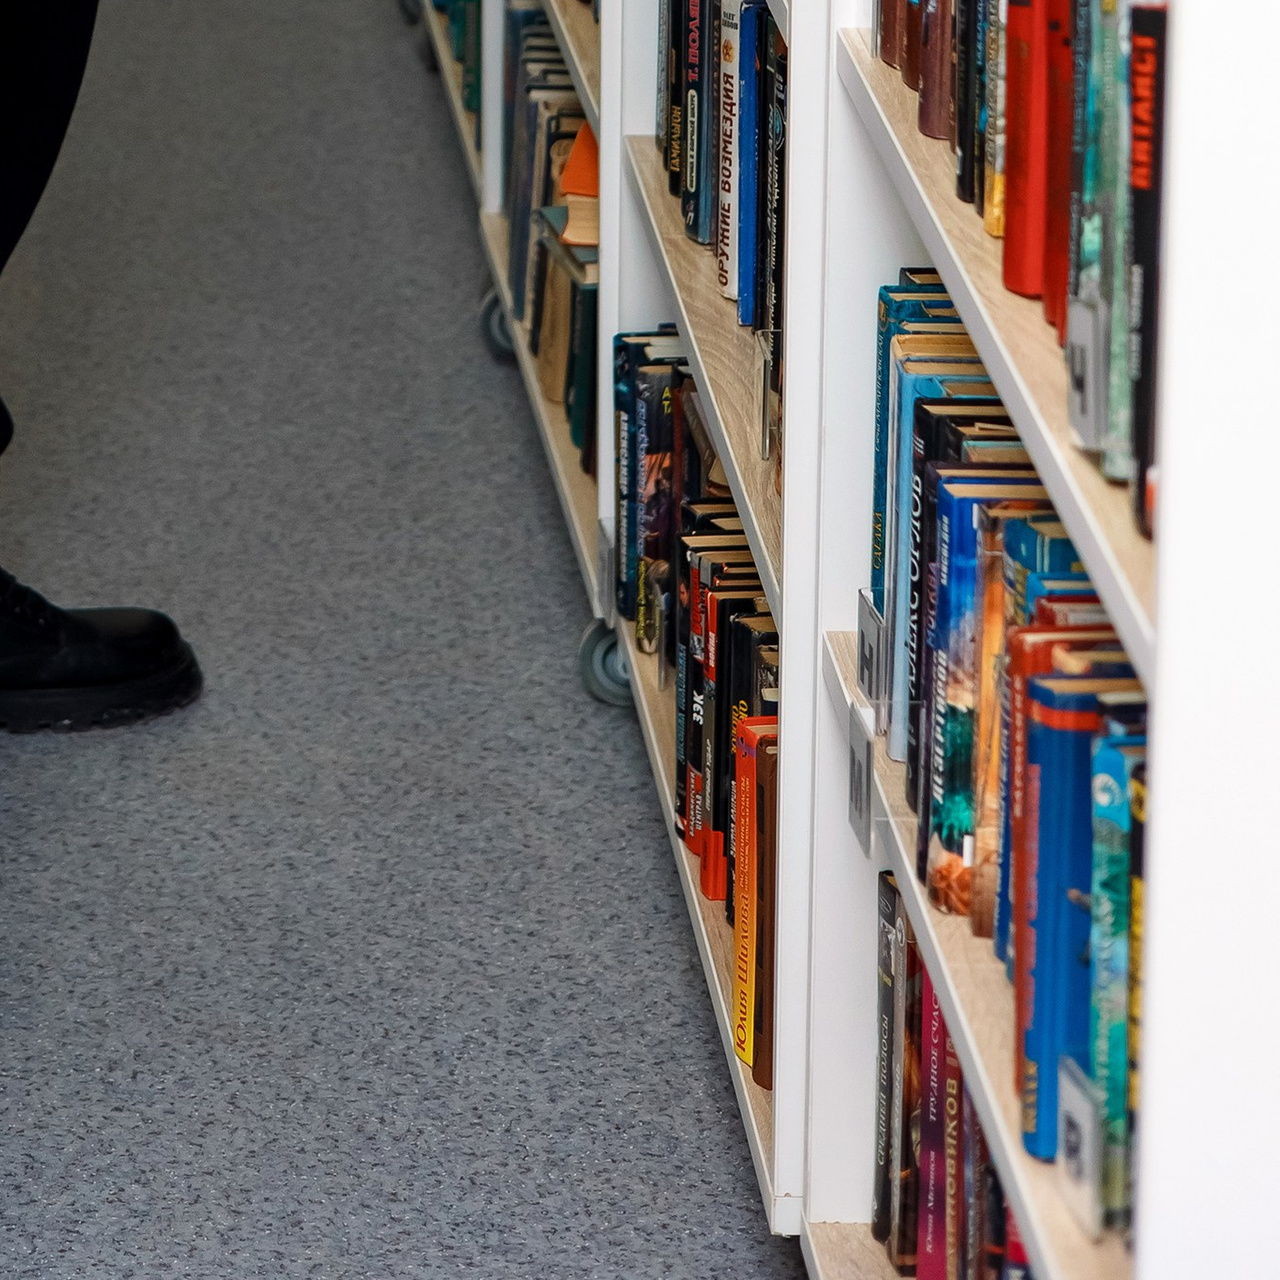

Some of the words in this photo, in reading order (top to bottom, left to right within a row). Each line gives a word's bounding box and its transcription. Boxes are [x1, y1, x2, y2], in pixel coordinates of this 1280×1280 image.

[720, 72, 736, 194] ВОЗМЕЗДИЯ
[717, 202, 731, 286] ОРУЖИЕ
[873, 510, 882, 570] СДЕЛКА
[910, 473, 923, 583] ОРЛОВ
[908, 590, 919, 697] АЛЕКС
[692, 690, 704, 725] ЗЭК
[737, 892, 750, 985] Шилова
[736, 989, 747, 1052] Юлия
[879, 1013, 889, 1086] ПОЛОСЫ
[929, 1047, 939, 1122] ТРУДНОЕ
[877, 1092, 888, 1166] СРЕДНЕЙ
